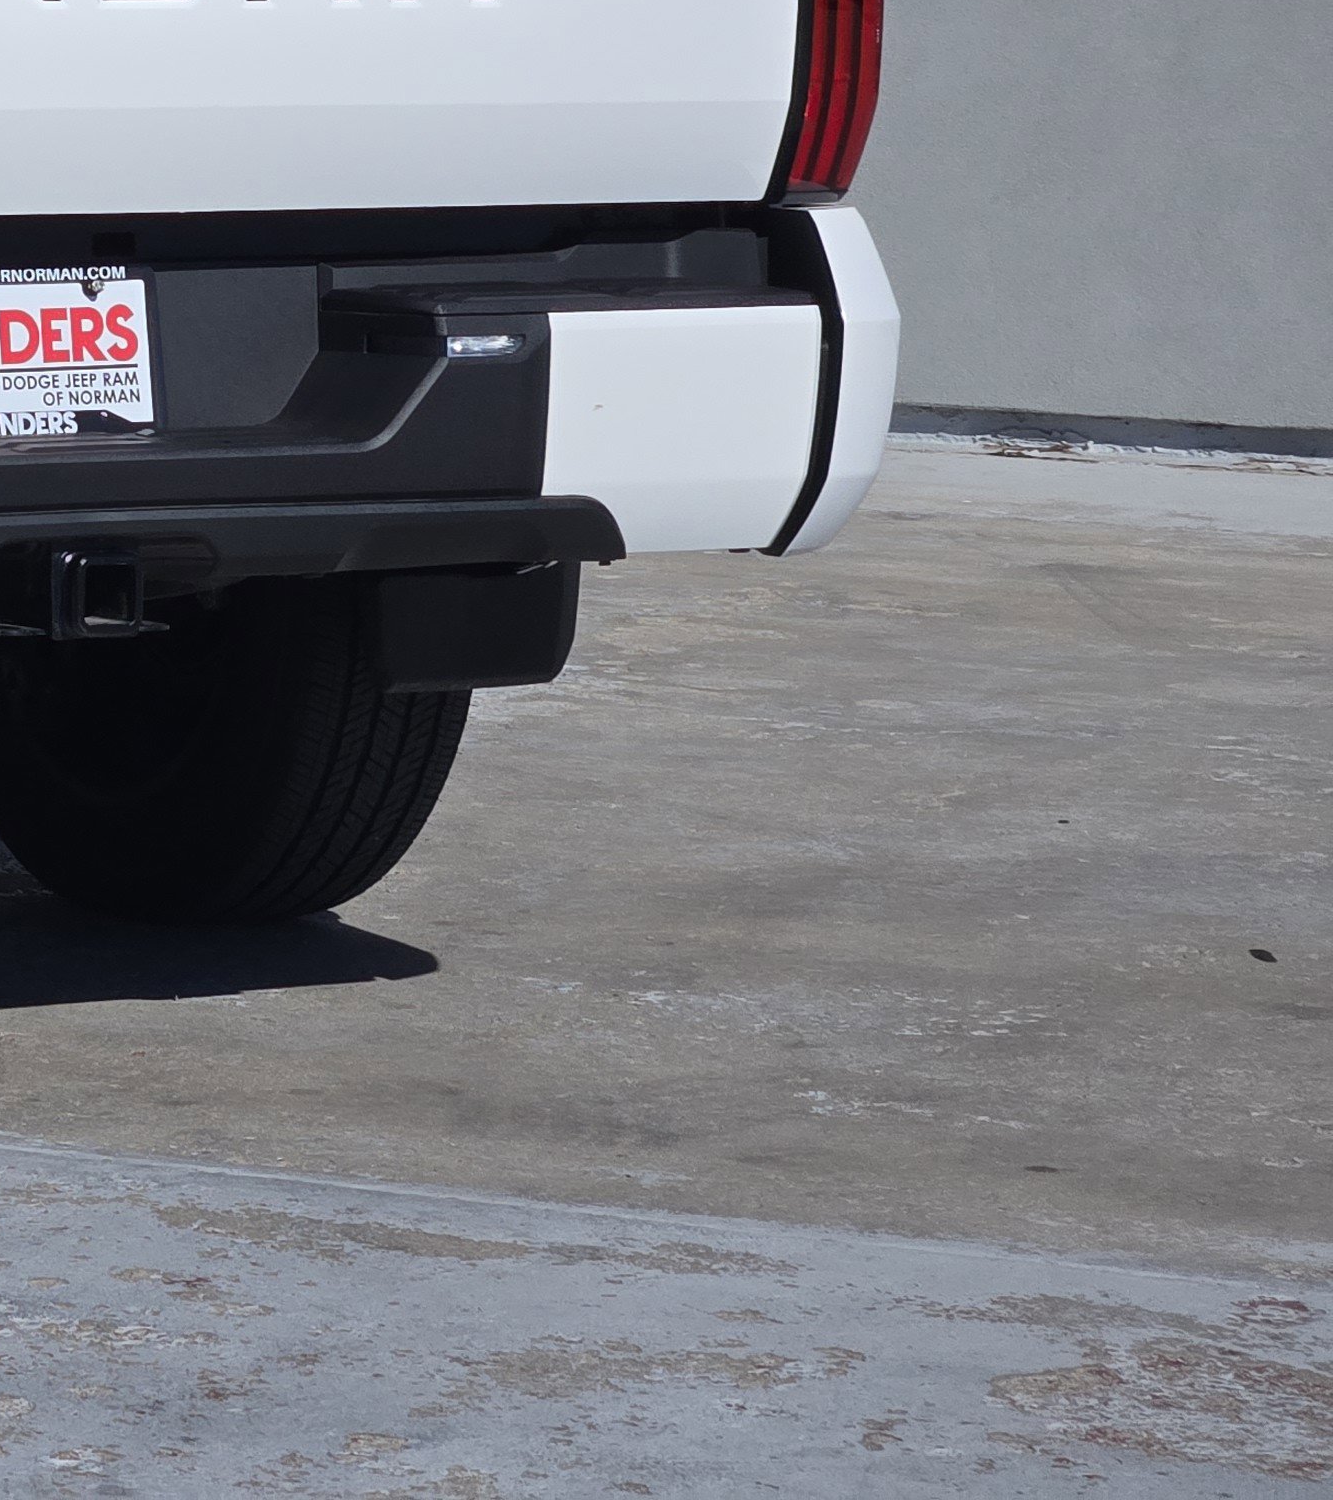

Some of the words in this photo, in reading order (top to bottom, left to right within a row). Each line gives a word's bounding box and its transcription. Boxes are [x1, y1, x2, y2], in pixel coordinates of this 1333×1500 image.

[2, 374, 60, 391] DODGE
[64, 372, 97, 388] JEEP
[103, 371, 139, 387] RAM
[43, 391, 65, 407] OF
[68, 389, 141, 406] NORMAN
